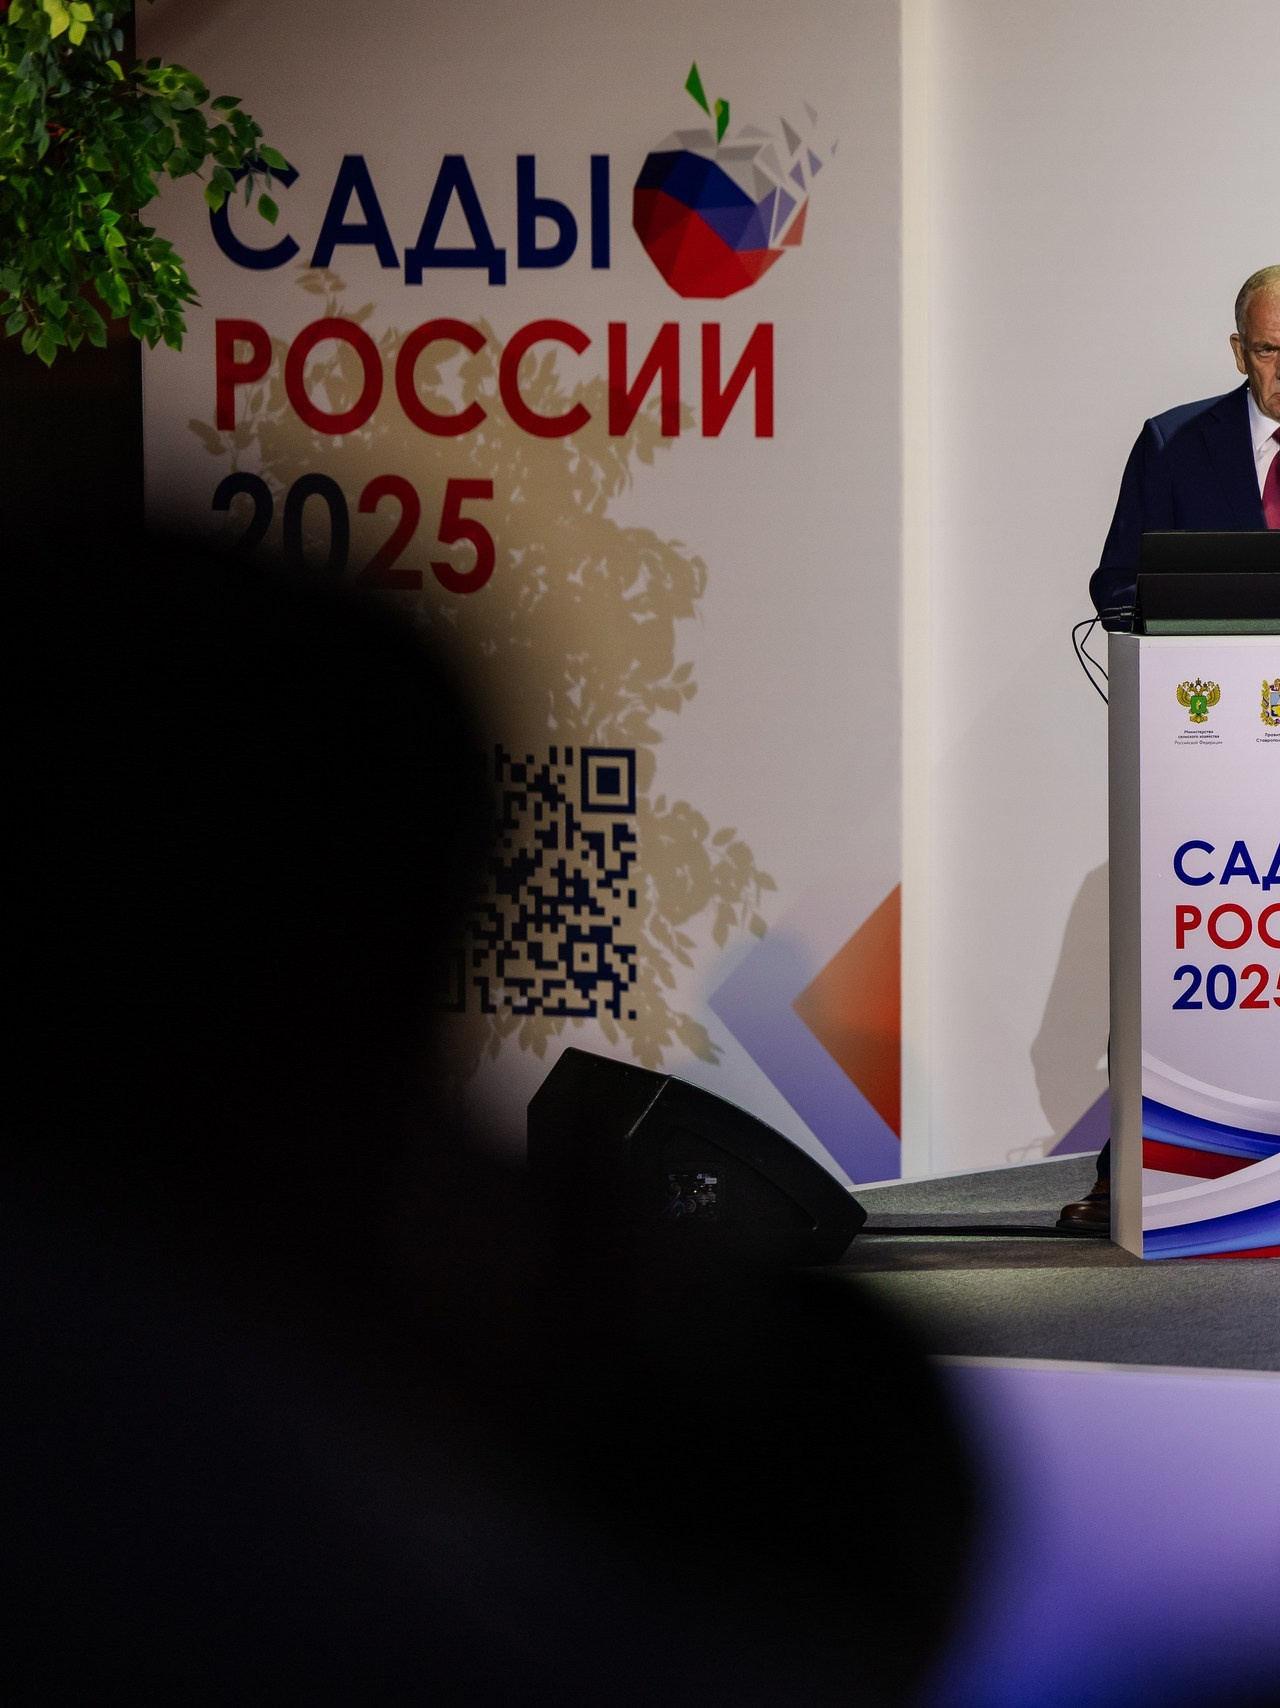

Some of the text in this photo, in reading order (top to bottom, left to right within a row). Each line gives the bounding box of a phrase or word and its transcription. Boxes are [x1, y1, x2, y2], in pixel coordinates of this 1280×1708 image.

[209, 153, 611, 287] САДЫ
[215, 317, 775, 439] РОССИИ
[211, 471, 496, 594] 2025
